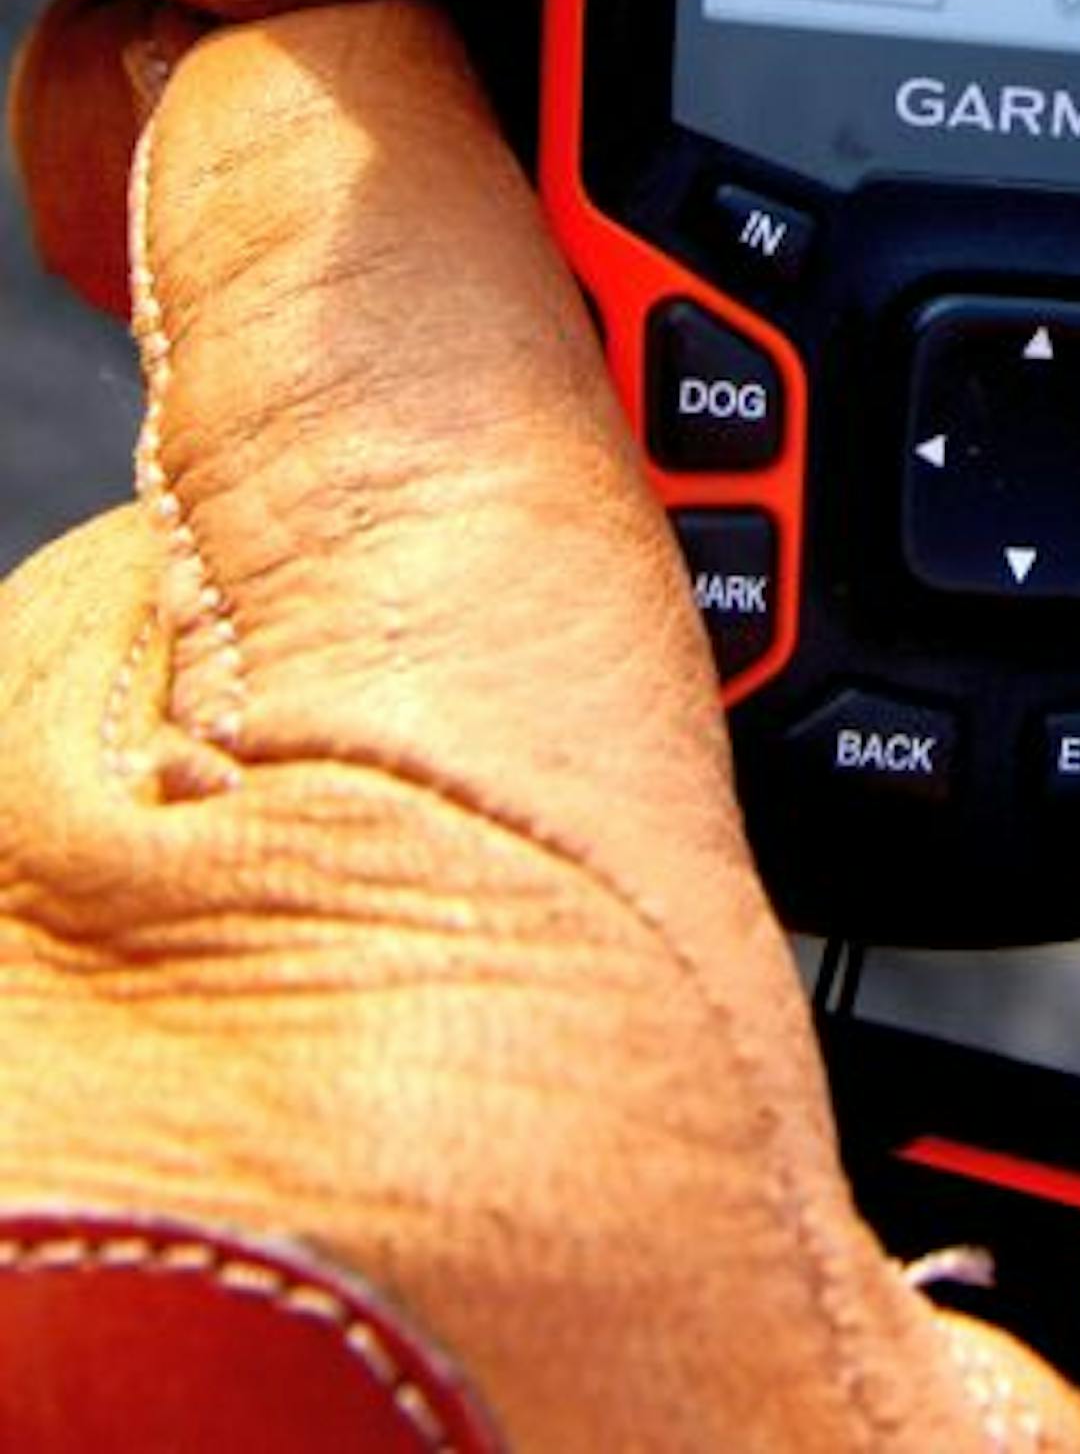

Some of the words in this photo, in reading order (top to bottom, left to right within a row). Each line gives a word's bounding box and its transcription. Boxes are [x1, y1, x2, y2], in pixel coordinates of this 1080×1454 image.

[740, 210, 785, 258] IN
[679, 379, 767, 421] DOG
[835, 729, 933, 775] BACK
